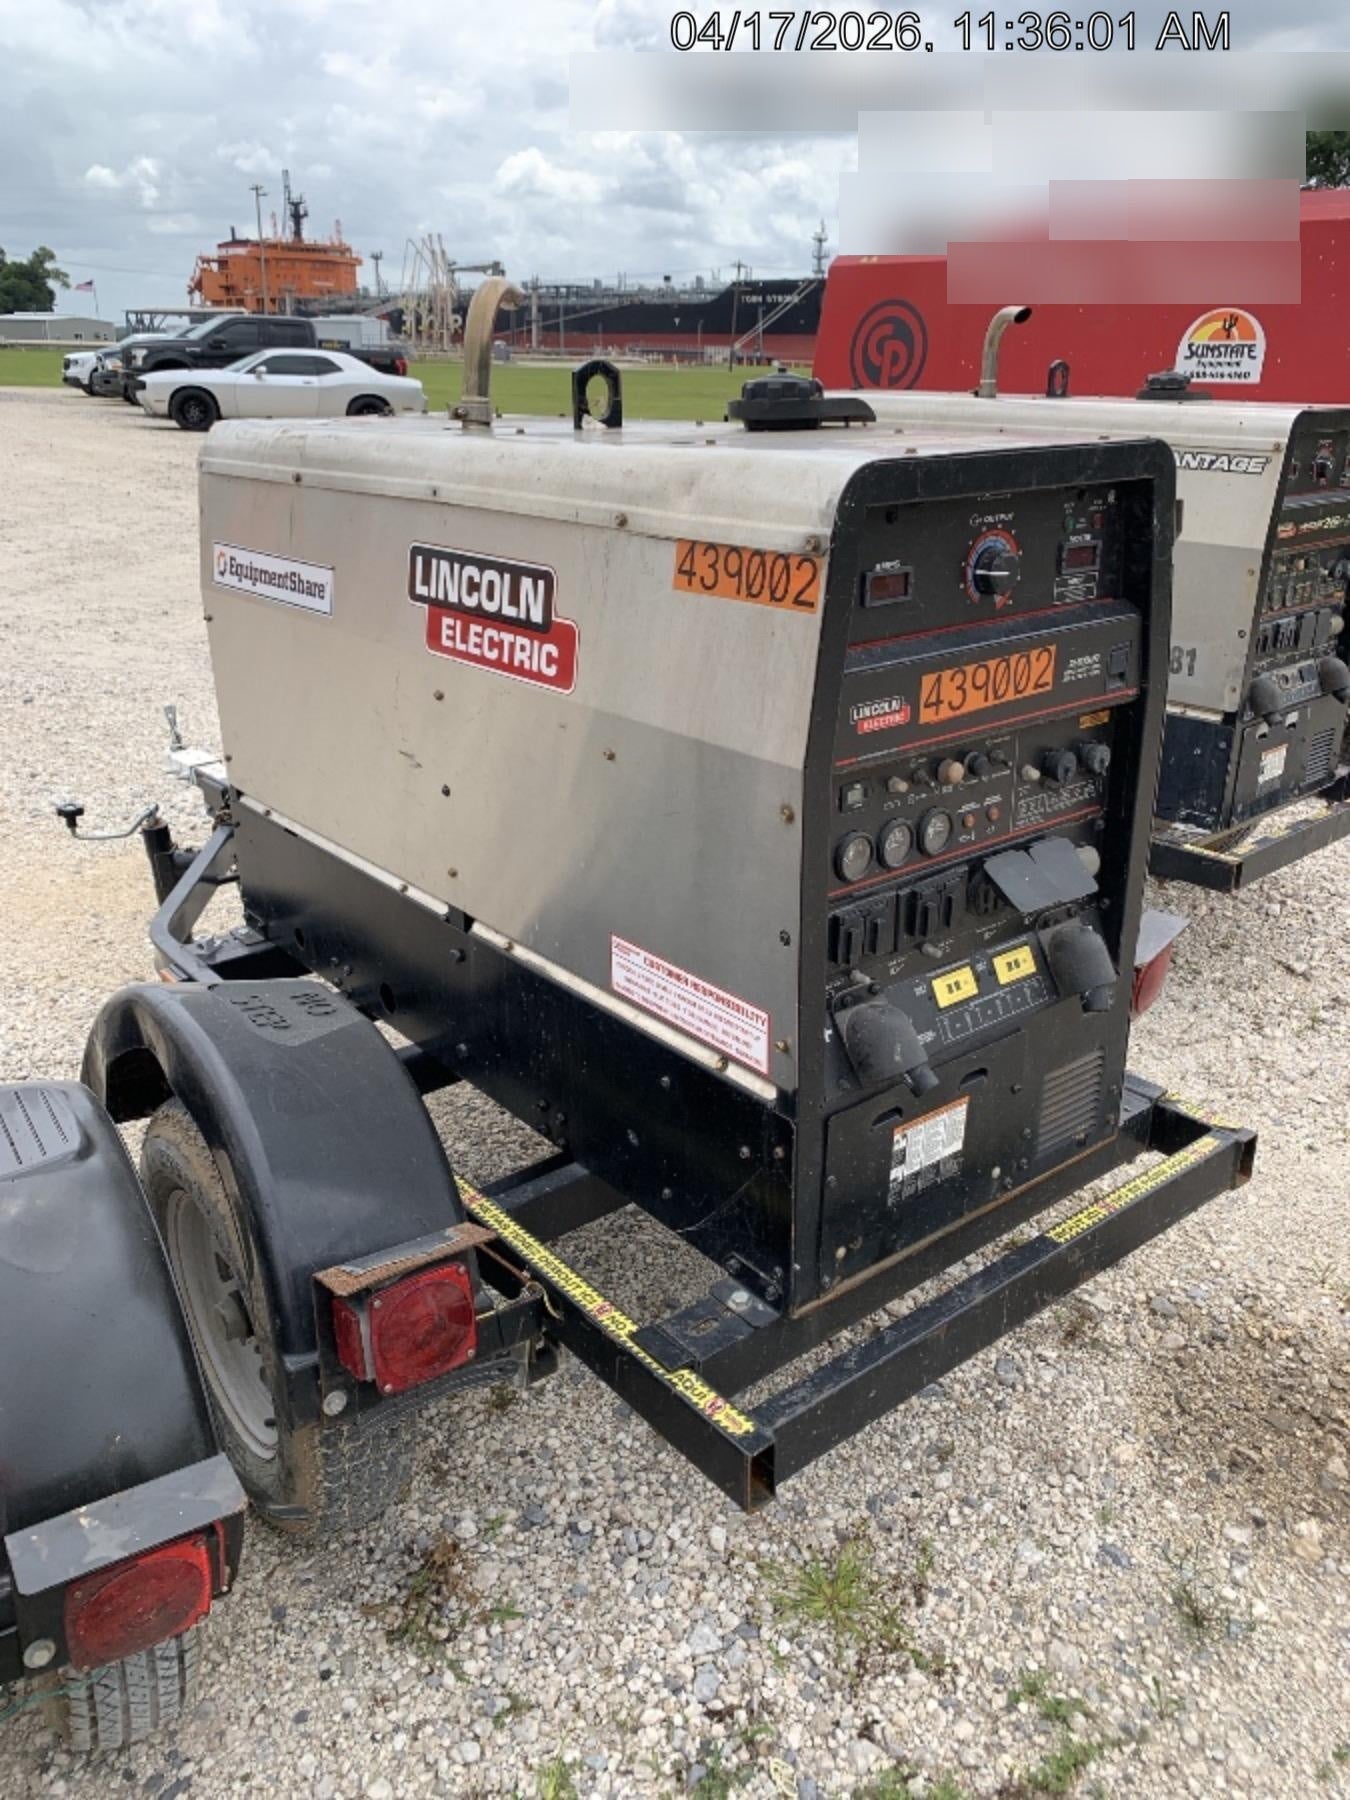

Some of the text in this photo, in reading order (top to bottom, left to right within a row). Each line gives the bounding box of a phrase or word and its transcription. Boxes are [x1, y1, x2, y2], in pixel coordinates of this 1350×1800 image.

[1183, 342, 1258, 360] SUNSTATE
[228, 556, 327, 600] EquipmentShare
[415, 555, 545, 625] LINCOLN
[677, 540, 819, 609] 439002
[440, 616, 559, 678] ELECTRIC
[853, 699, 902, 721] LINCOLN
[924, 647, 1054, 715] 439002
